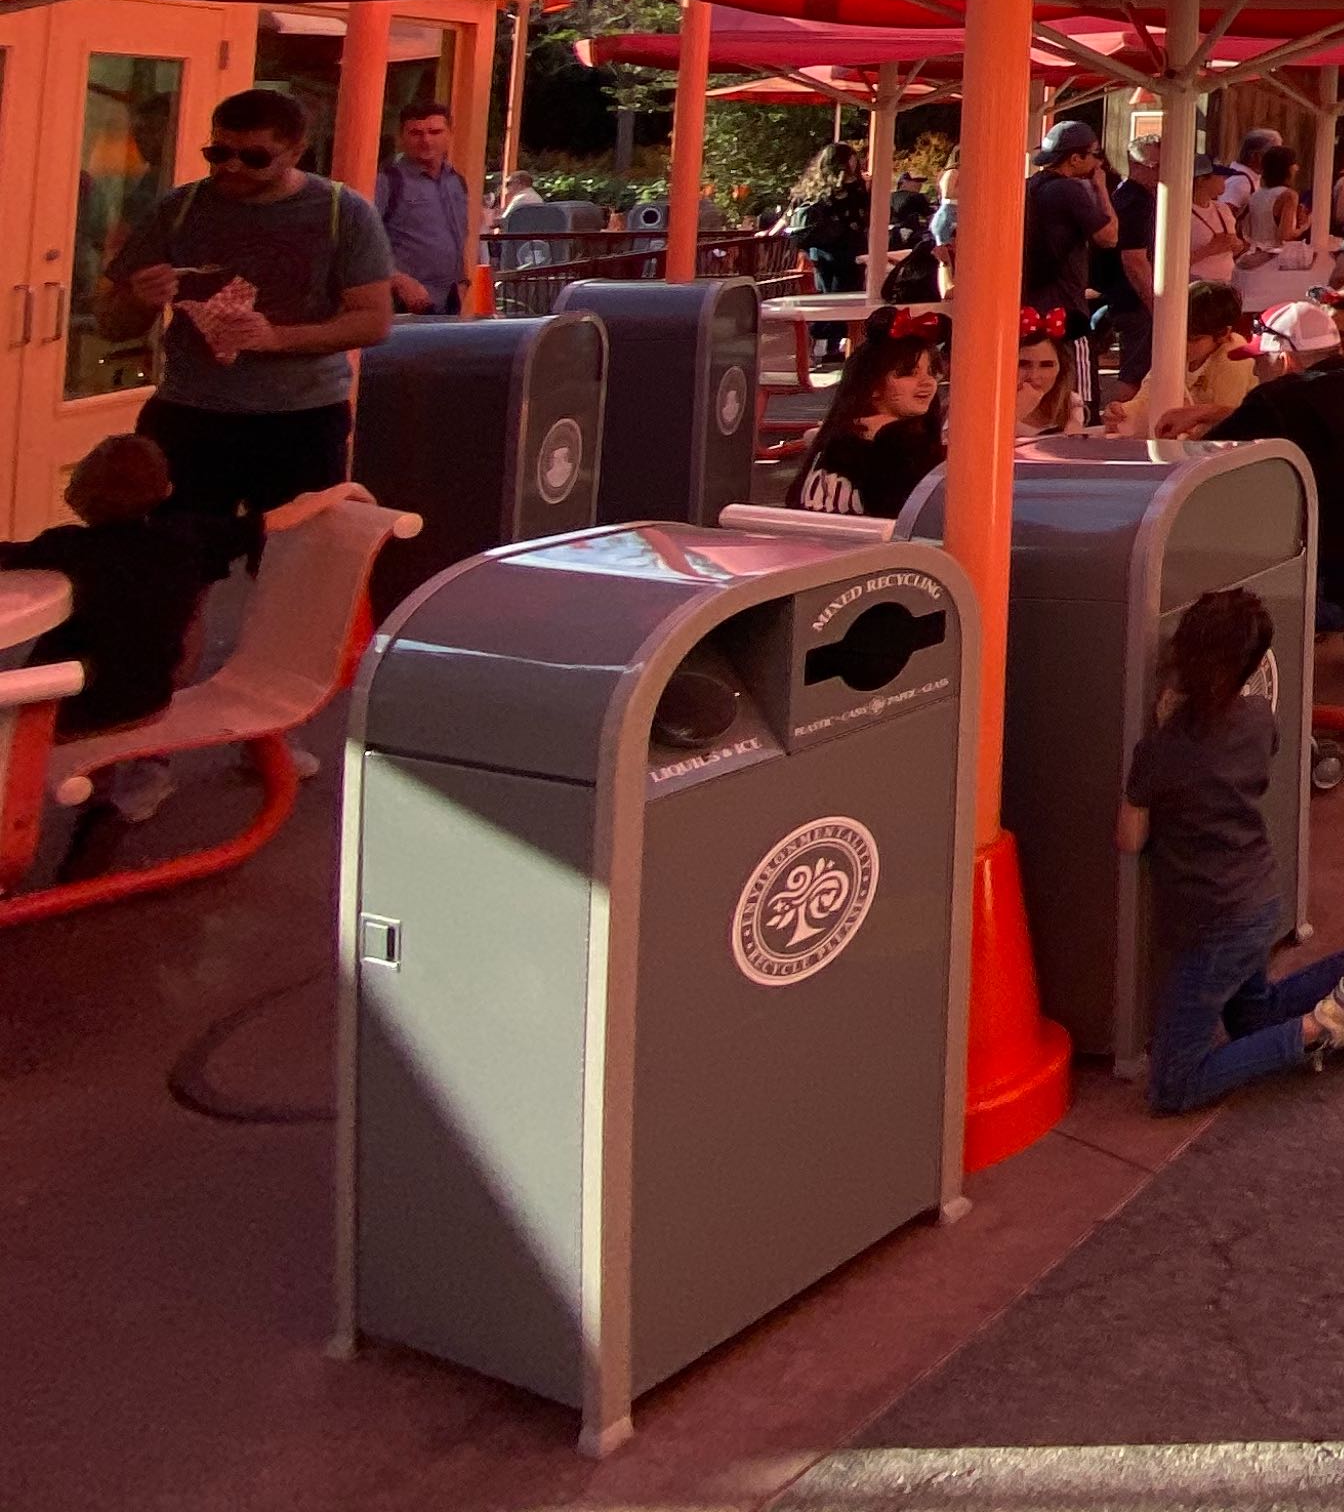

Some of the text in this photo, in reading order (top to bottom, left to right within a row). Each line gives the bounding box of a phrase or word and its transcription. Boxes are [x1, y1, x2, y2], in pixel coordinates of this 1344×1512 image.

[812, 572, 946, 633] MIXED RECYCLING
[734, 737, 763, 755] ICE
[748, 949, 811, 976] RECYCLE
